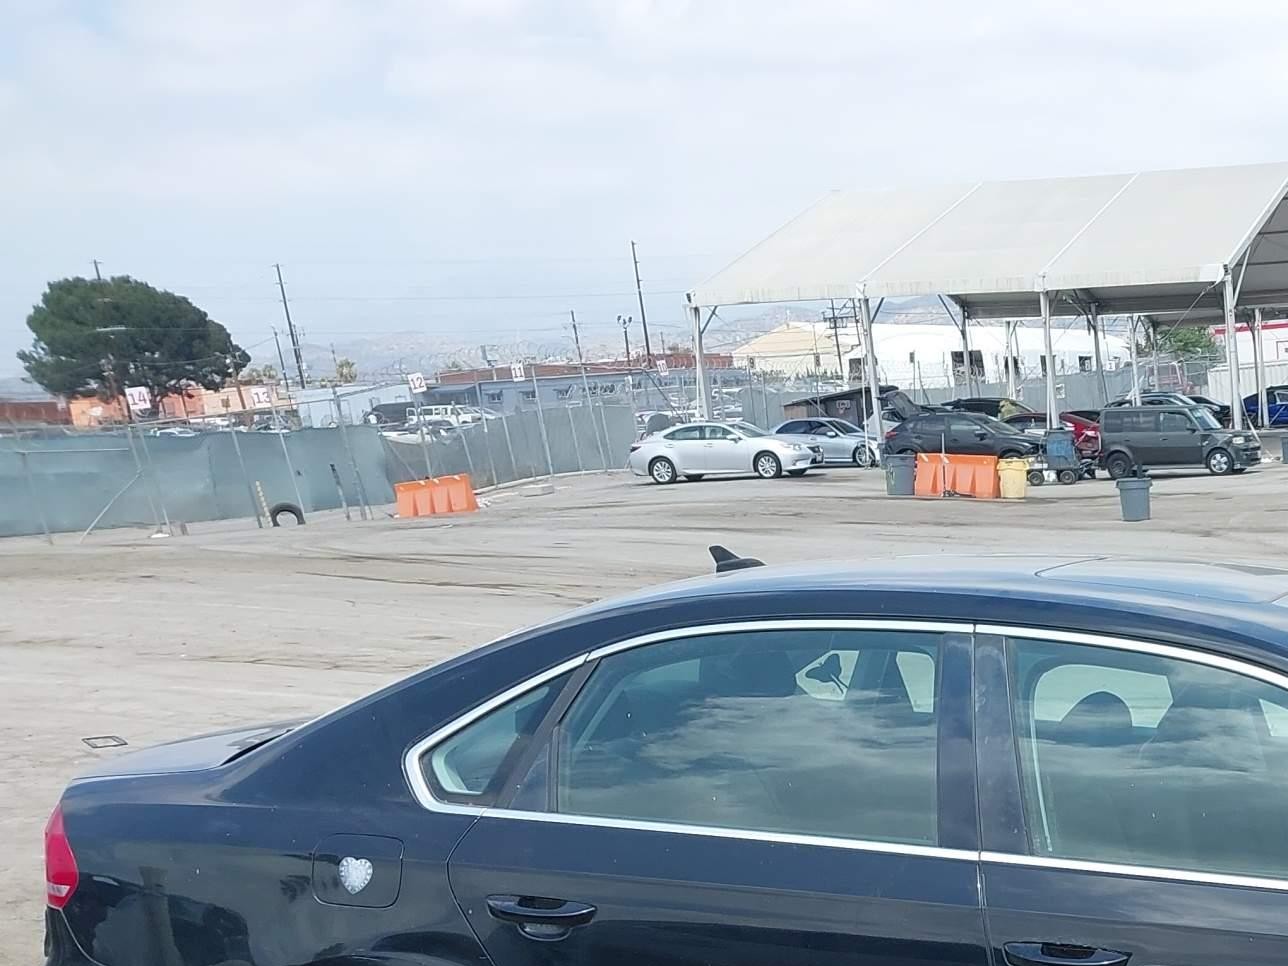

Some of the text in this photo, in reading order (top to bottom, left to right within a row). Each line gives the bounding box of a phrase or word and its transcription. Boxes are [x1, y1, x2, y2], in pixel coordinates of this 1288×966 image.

[512, 366, 524, 378] 11
[410, 376, 425, 391] 12
[128, 391, 148, 406] 14
[253, 391, 271, 404] 13
